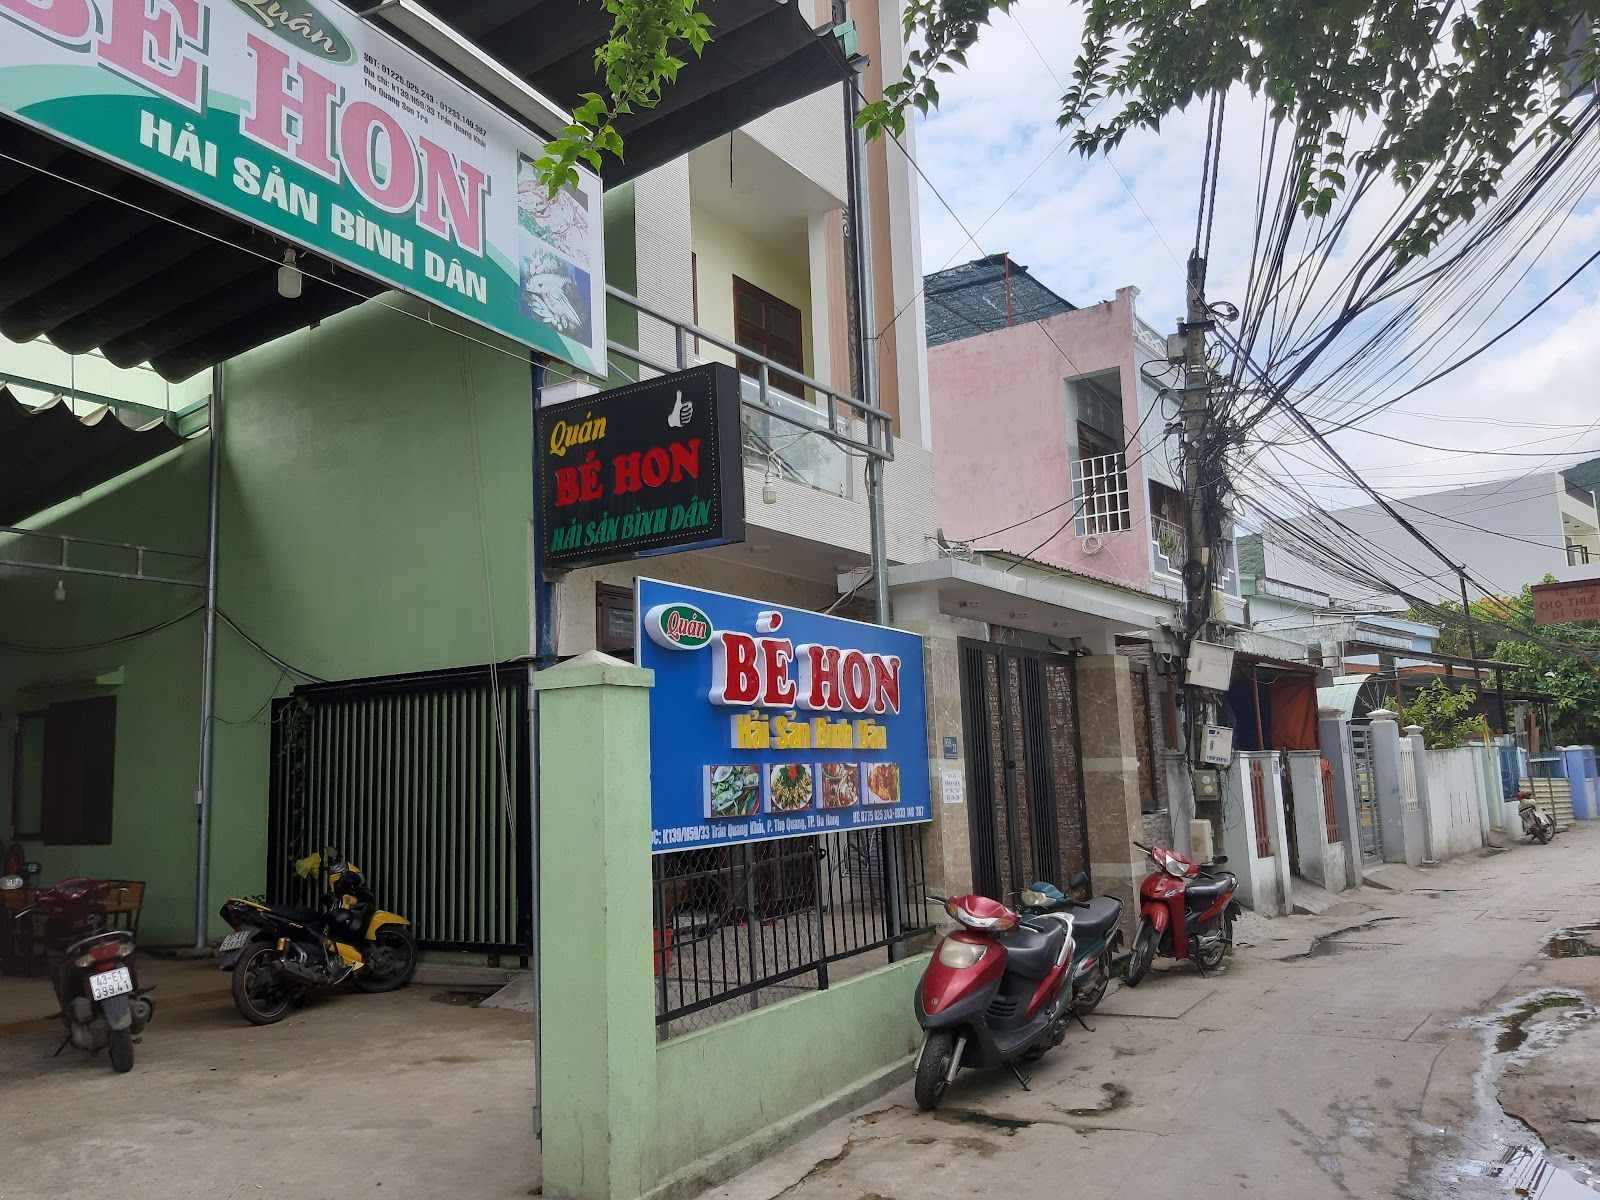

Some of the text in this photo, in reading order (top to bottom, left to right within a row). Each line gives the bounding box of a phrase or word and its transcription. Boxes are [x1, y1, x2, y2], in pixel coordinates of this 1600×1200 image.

[378, 87, 400, 108] Quang
[240, 30, 491, 258] HON
[139, 109, 487, 305] HẢI SẢN BÌNH DÂN
[549, 411, 607, 457] Quán
[555, 438, 701, 507] BÉ HON
[551, 495, 713, 553] HẢI SẢN BÌNH DÂN
[667, 610, 707, 641] Quán
[718, 611, 902, 715] BÉ HON
[732, 710, 770, 749] Hải
[771, 711, 811, 749] Sản
[727, 823, 749, 838] Quang
